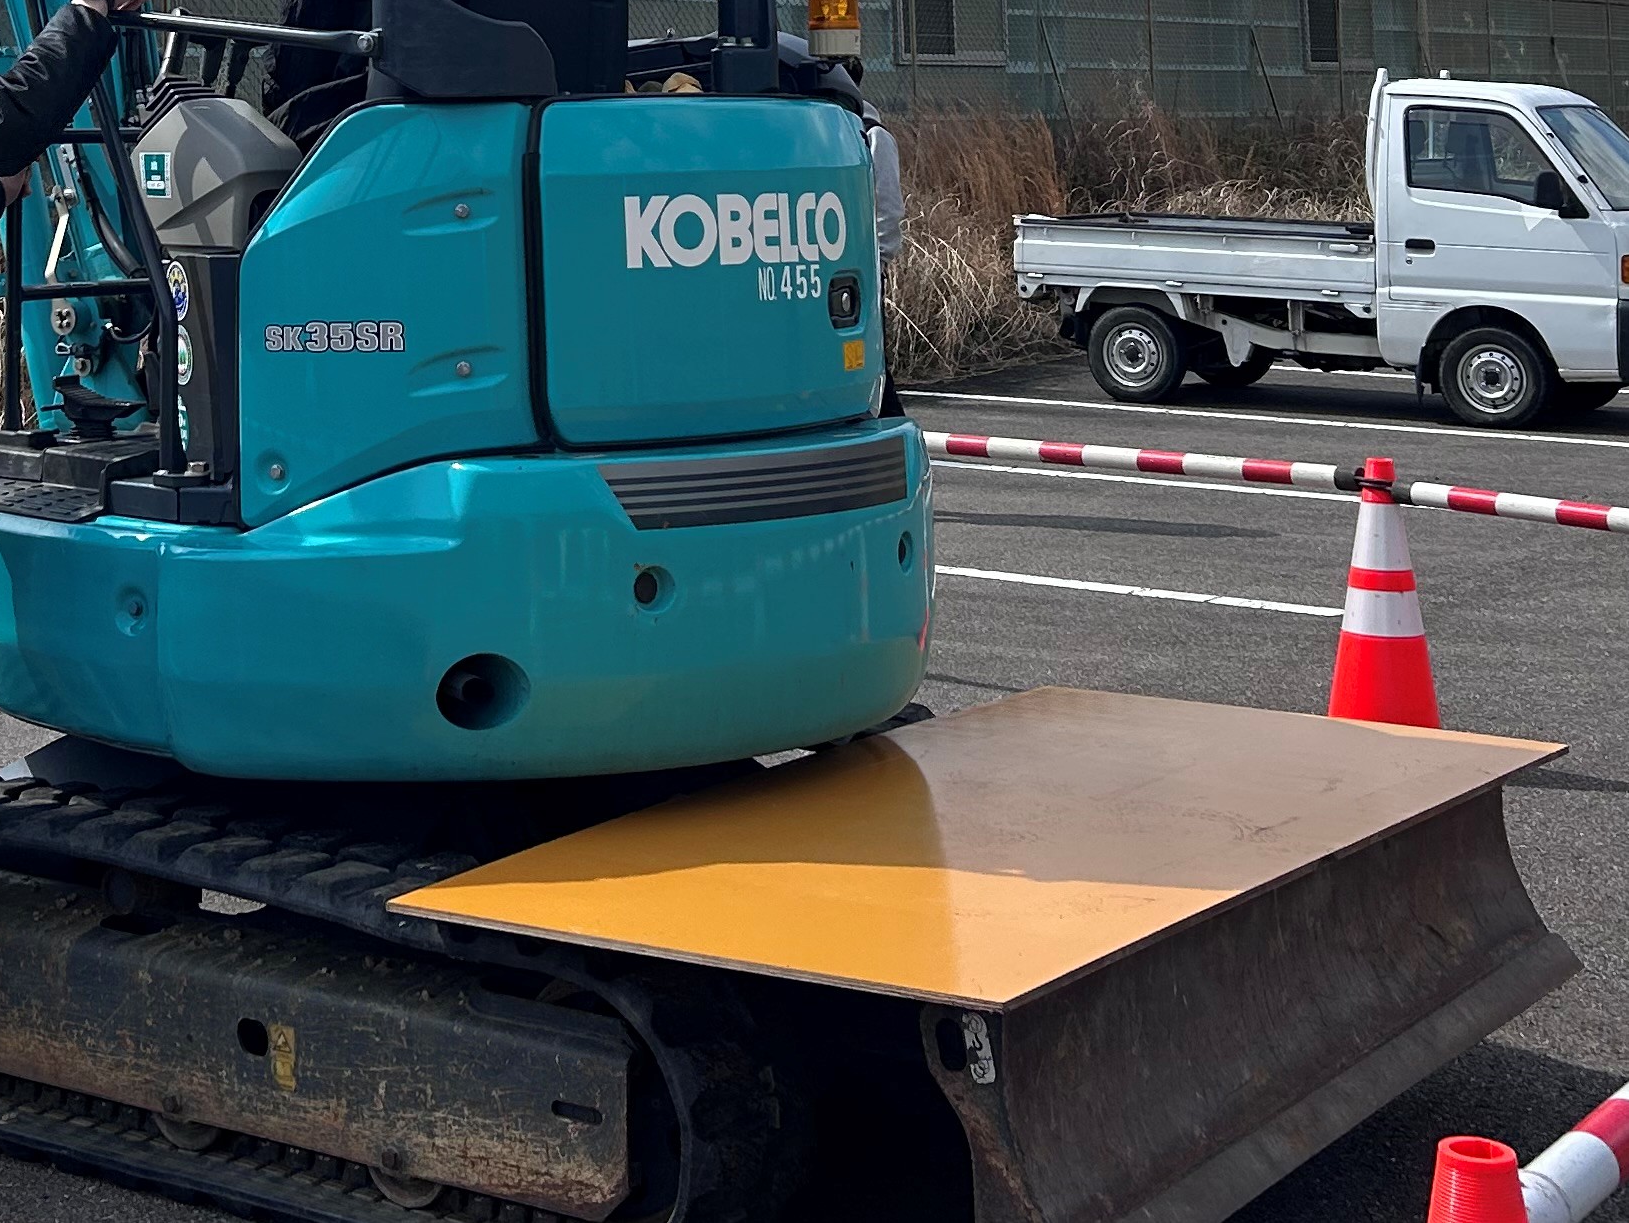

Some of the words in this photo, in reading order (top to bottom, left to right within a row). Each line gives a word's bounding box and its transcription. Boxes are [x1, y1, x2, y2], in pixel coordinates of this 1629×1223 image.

[624, 191, 847, 268] KOBELCO
[781, 264, 821, 299] 455
[264, 320, 405, 352] SK35SR
